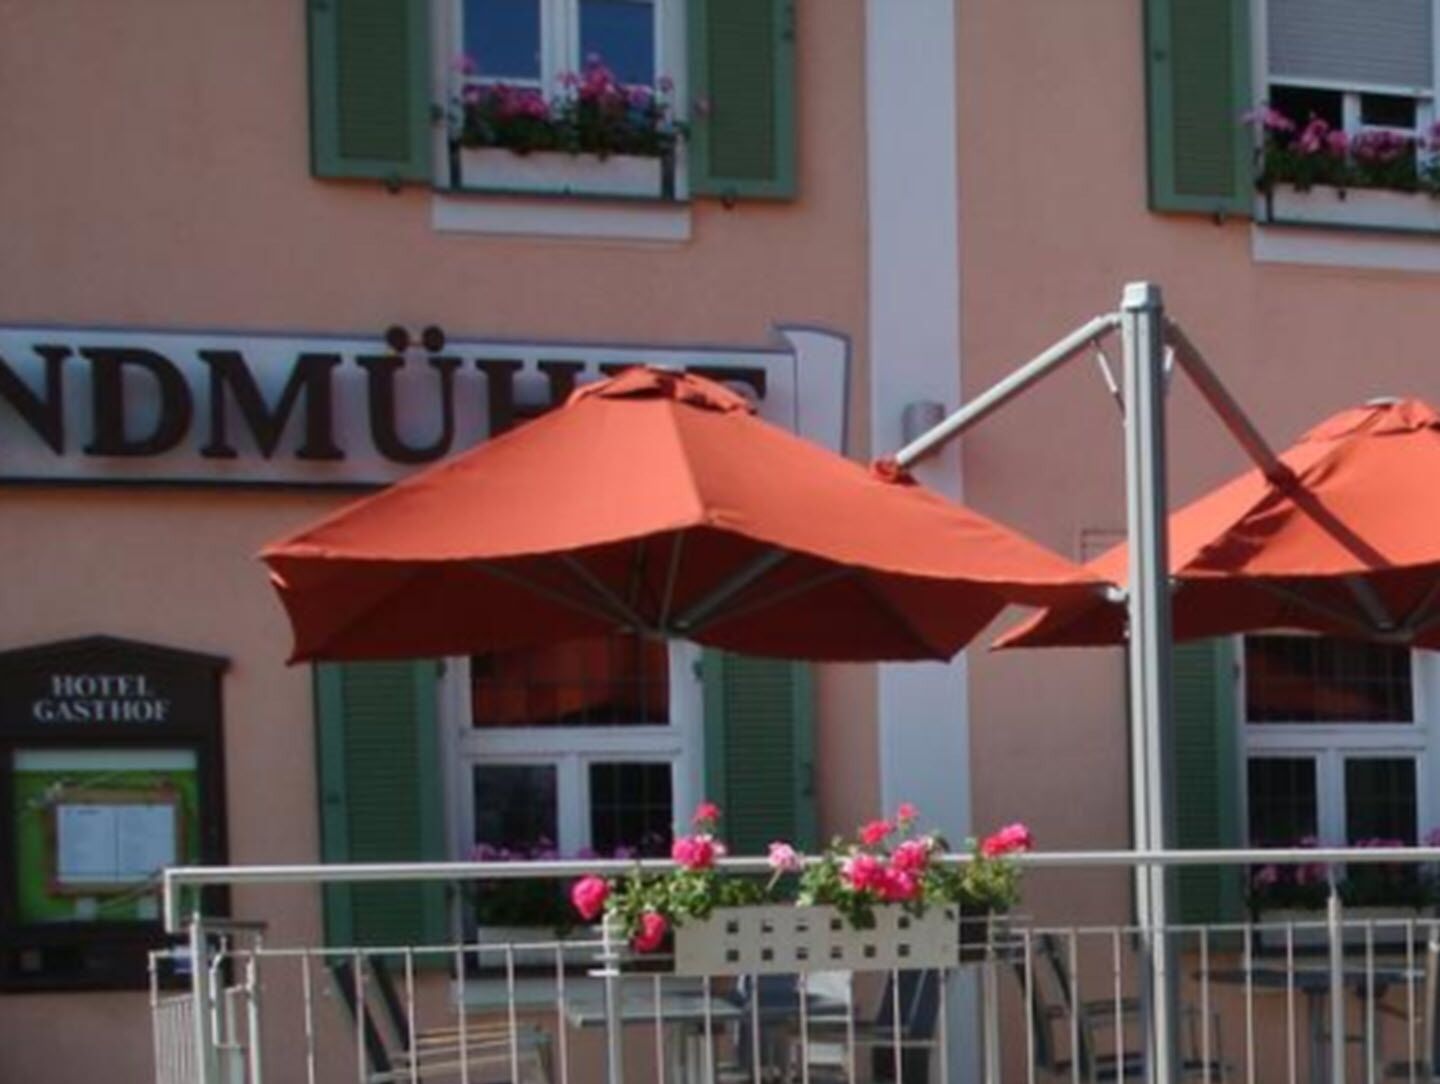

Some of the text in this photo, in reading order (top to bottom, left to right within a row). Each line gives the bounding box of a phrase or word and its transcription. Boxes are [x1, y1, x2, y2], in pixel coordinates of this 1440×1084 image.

[0, 325, 767, 464] NDMÜH
[51, 674, 153, 697] HOTEL
[32, 699, 171, 722] GASTHOF
